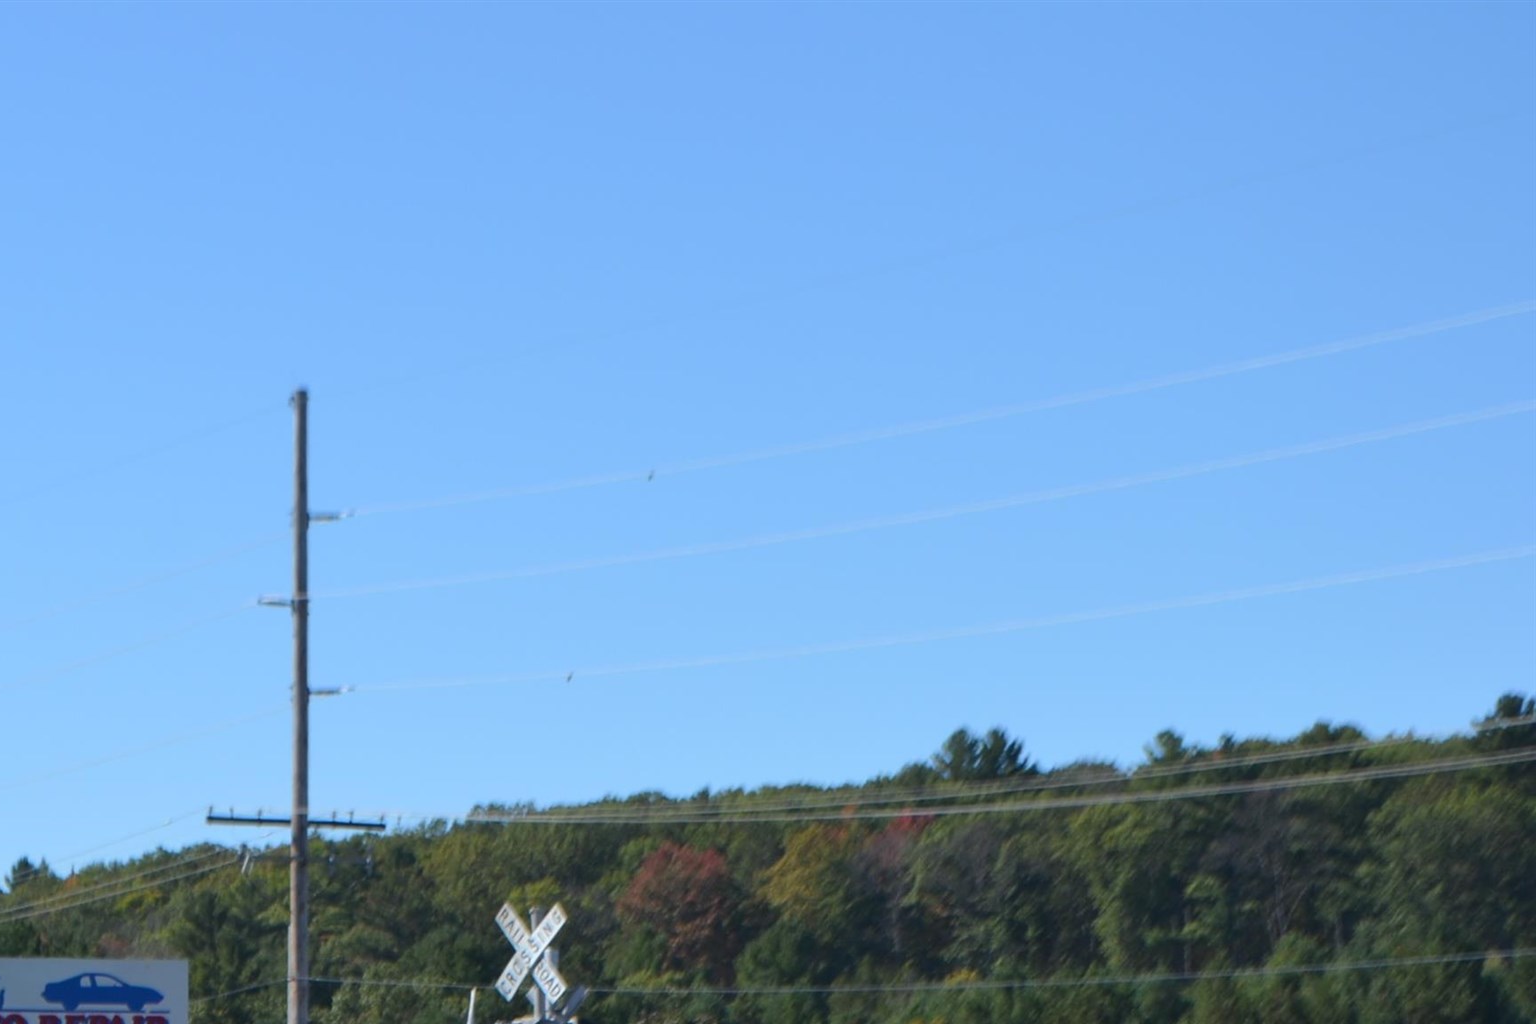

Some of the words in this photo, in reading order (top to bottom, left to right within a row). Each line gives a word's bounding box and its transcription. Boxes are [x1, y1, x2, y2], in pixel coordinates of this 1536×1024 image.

[499, 908, 525, 947] RAIL
[500, 910, 563, 996] CROSSING
[535, 961, 563, 998] ROAD
